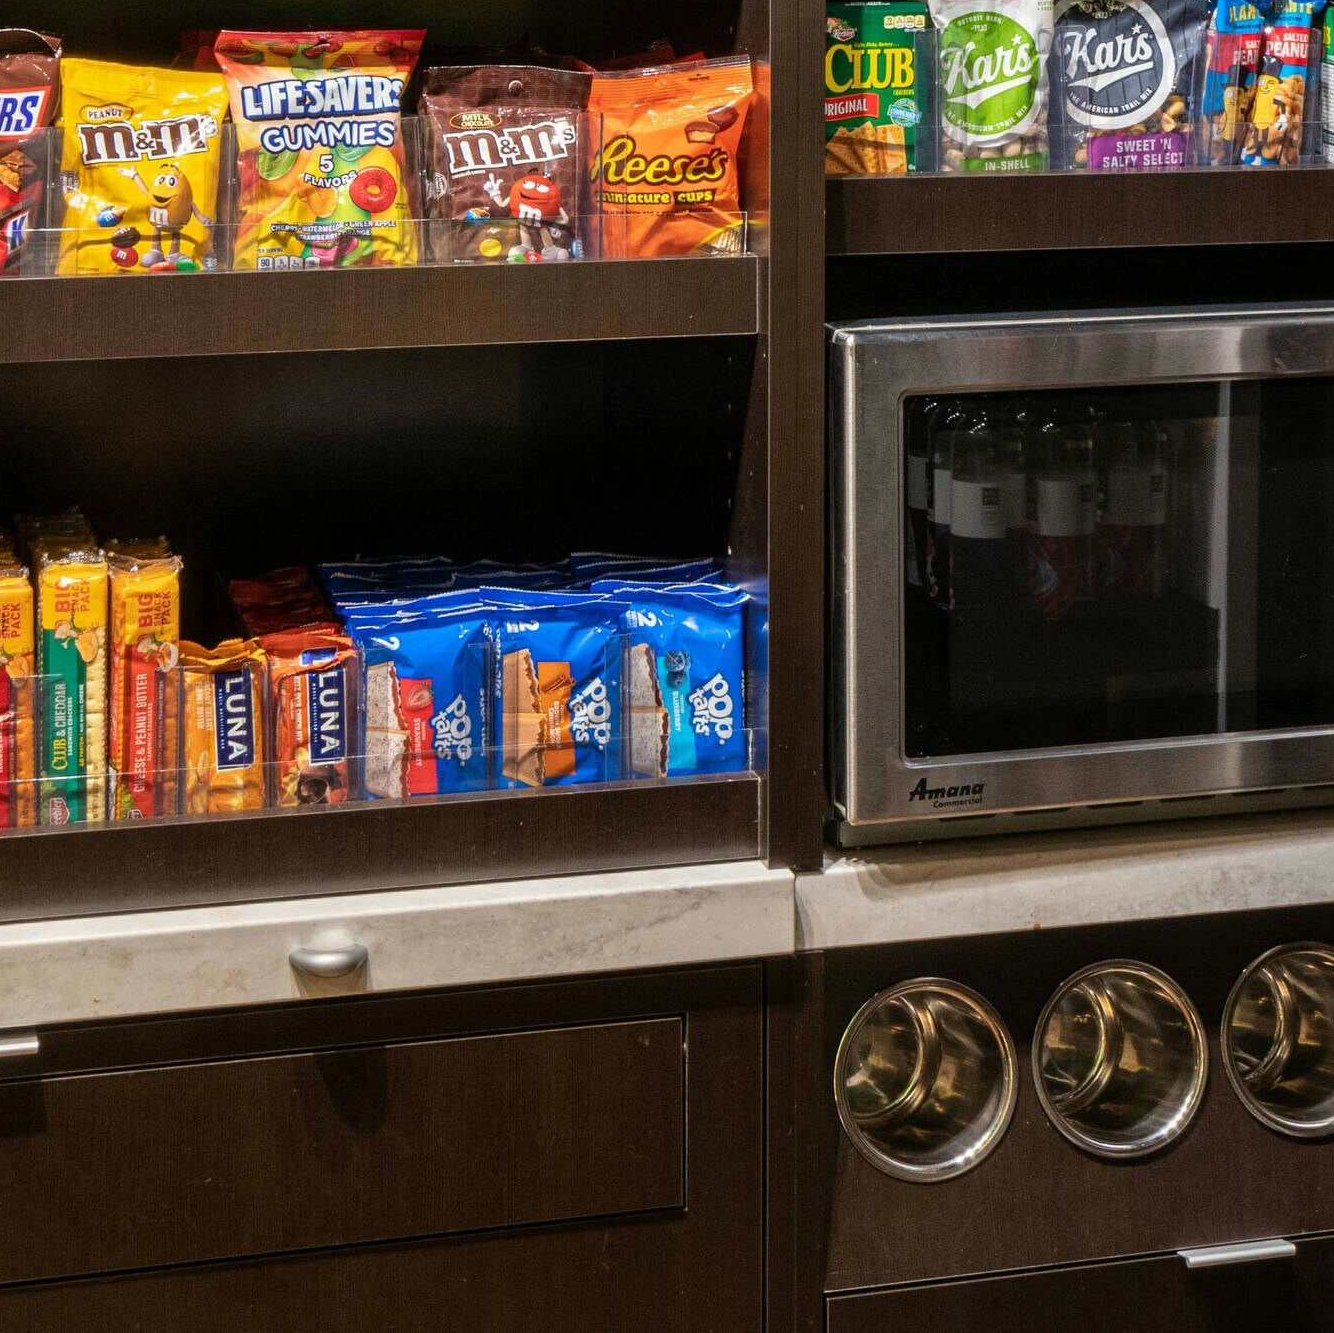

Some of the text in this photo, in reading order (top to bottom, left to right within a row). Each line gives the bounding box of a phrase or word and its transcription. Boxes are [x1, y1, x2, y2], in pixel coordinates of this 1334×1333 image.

[1067, 25, 1152, 77] Kar's
[826, 43, 915, 92] CLUB
[942, 42, 1032, 94] Kar's
[263, 123, 394, 152] GUMMIES
[1116, 139, 1155, 153] SWEET
[319, 154, 334, 173] 5
[591, 137, 728, 182] Reese's
[984, 158, 1030, 172] IN-SHELL
[1103, 153, 1184, 169] SALTY SELECT
[304, 171, 358, 188] FLAVORS
[677, 191, 712, 202] cups
[55, 683, 66, 728] CHEDDAR
[226, 677, 247, 760] LUNA
[318, 672, 340, 754] LUNA
[135, 711, 147, 745] PEANUT
[908, 777, 986, 804] Amana
[933, 796, 983, 810] Commercial
